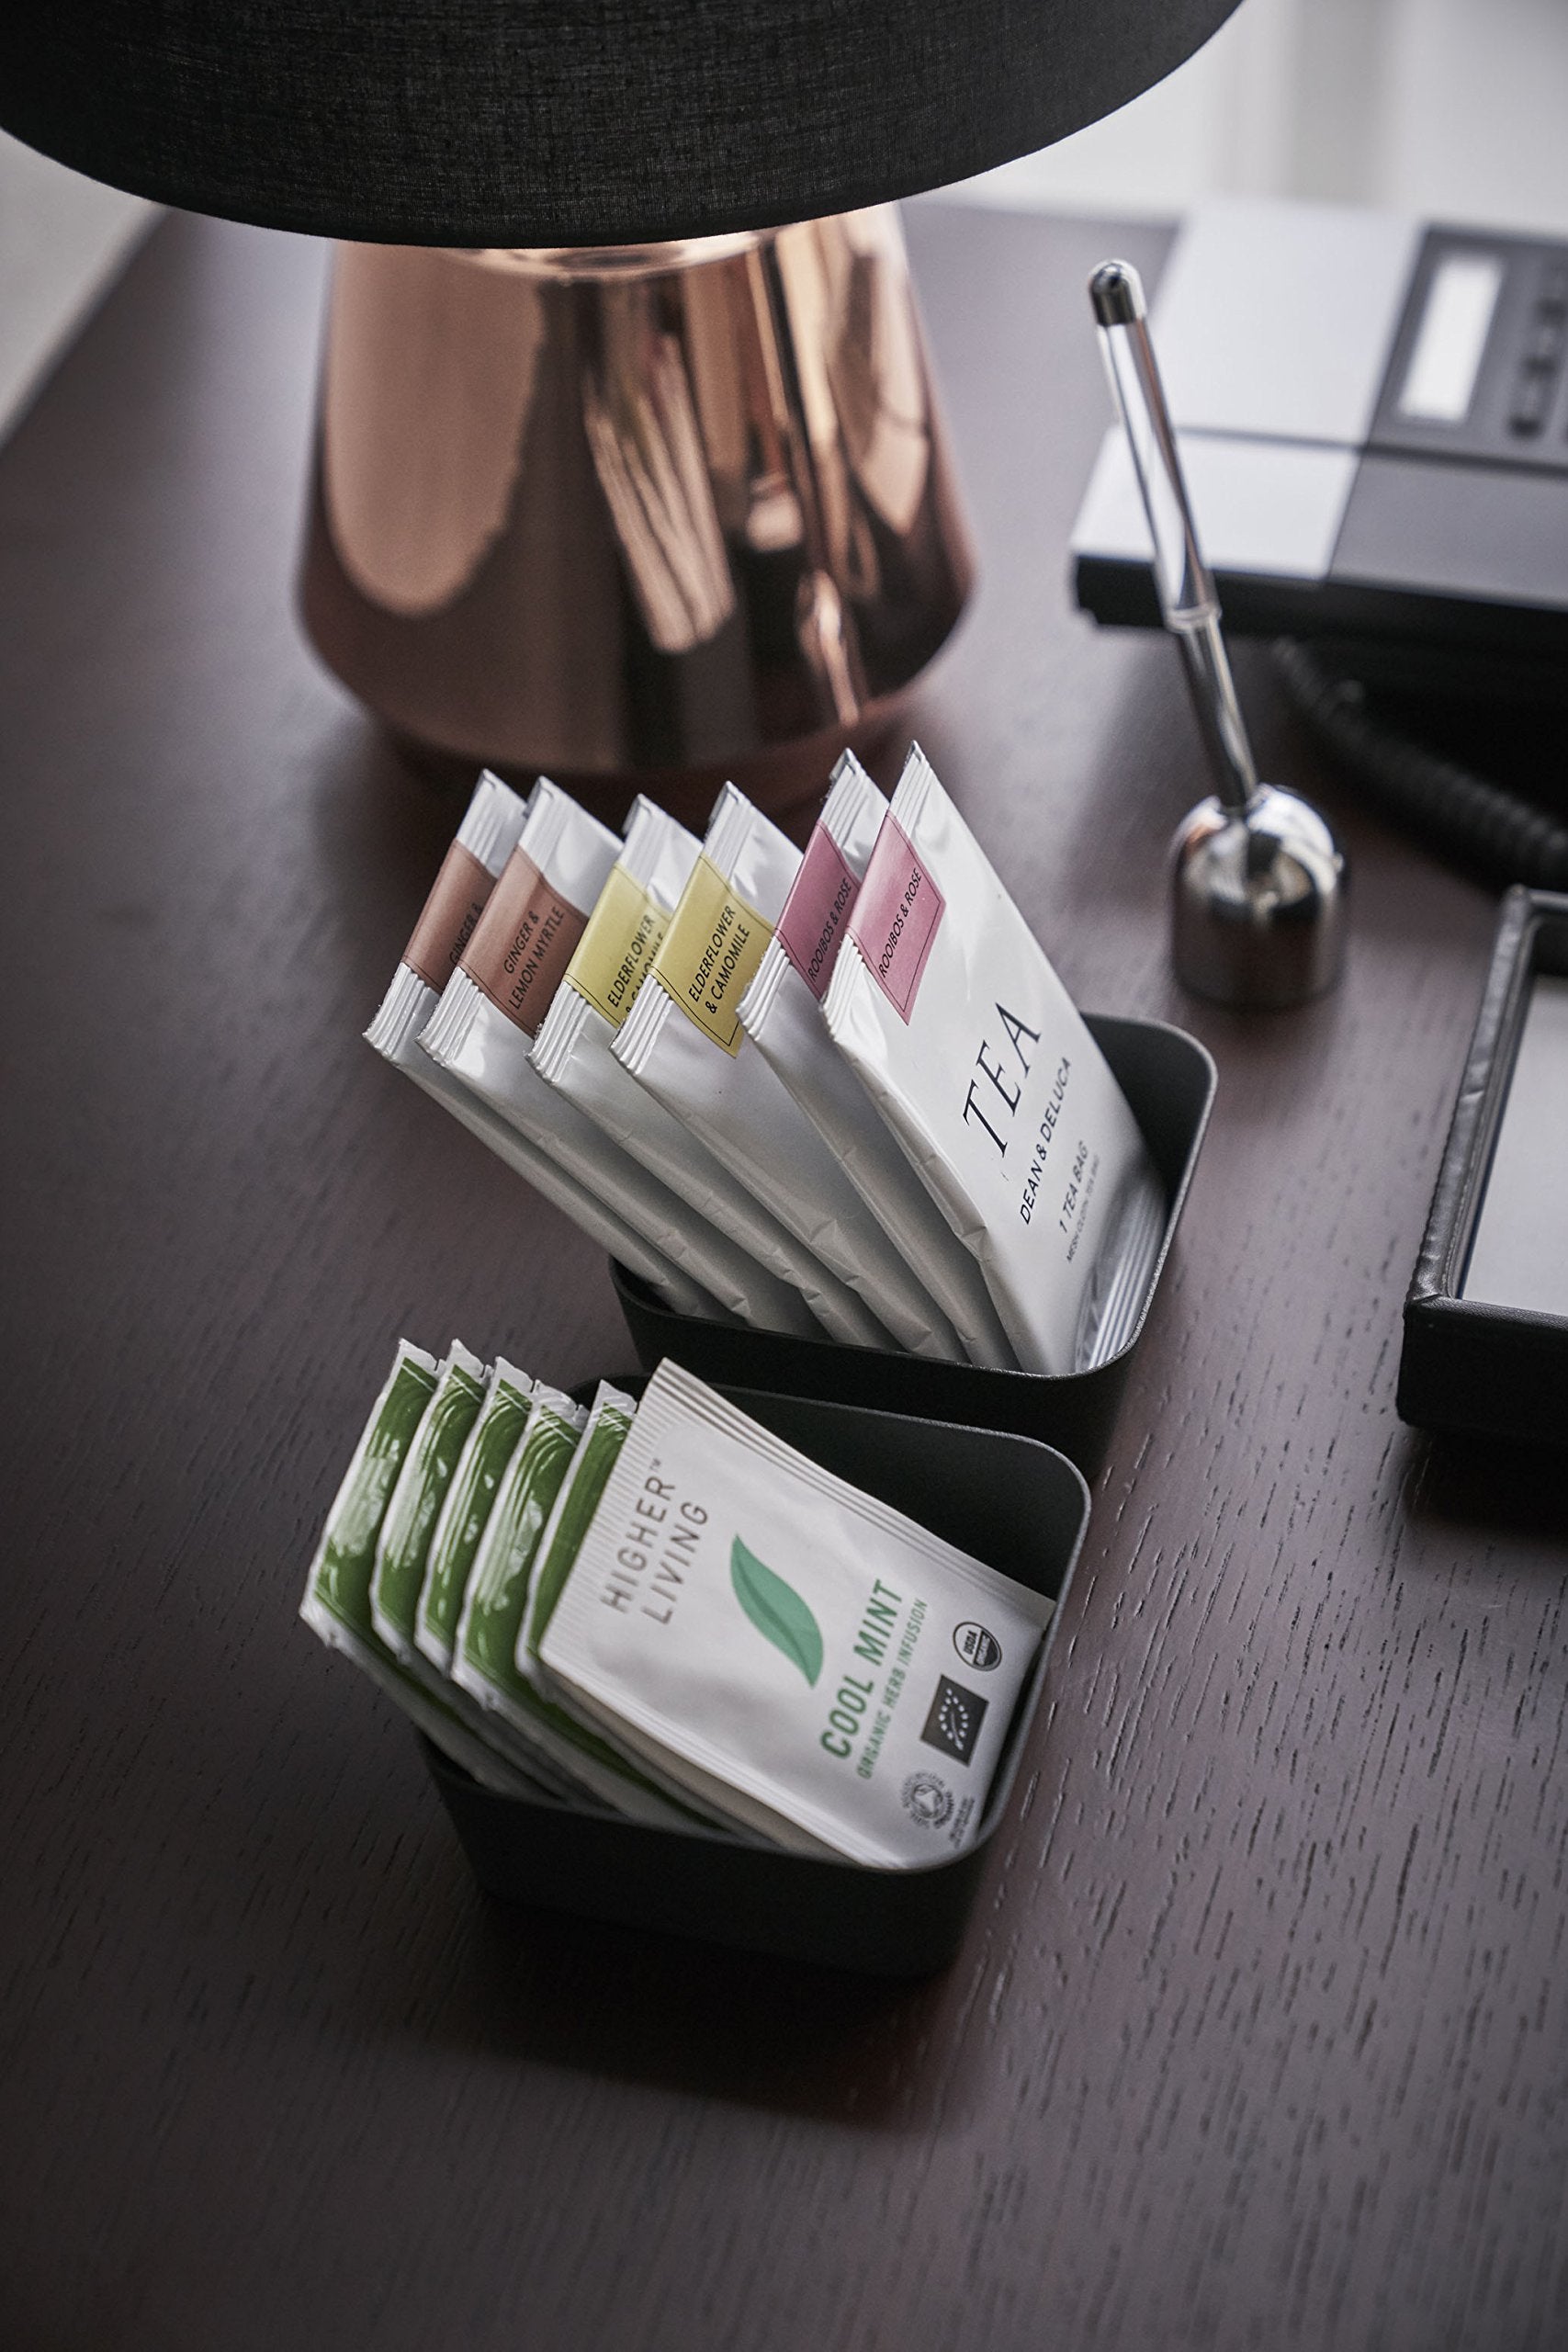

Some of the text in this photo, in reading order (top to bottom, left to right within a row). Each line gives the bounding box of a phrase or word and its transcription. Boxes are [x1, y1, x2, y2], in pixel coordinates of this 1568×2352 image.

[503, 910, 540, 975] GINGER &
[508, 907, 564, 1011] LEMON MYRTLE
[607, 914, 656, 1008] ELDERFLOWER
[688, 905, 736, 1003] ELDERFLOWER
[705, 923, 750, 1014] & CAMOMILE
[807, 876, 852, 982] ROOIBOS & ROSE
[878, 867, 921, 978] ROOIBOS & ROSE
[962, 1001, 1042, 1158] TEA
[1020, 1057, 1072, 1226] DEAN & DELUCA
[1059, 1139, 1089, 1233] 1 TEA BAG
[641, 1501, 708, 1625] LIVING
[820, 1578, 903, 1760] COOL MINT
[882, 1668, 907, 1710] HERB
[897, 1598, 928, 1667] INFUSION
